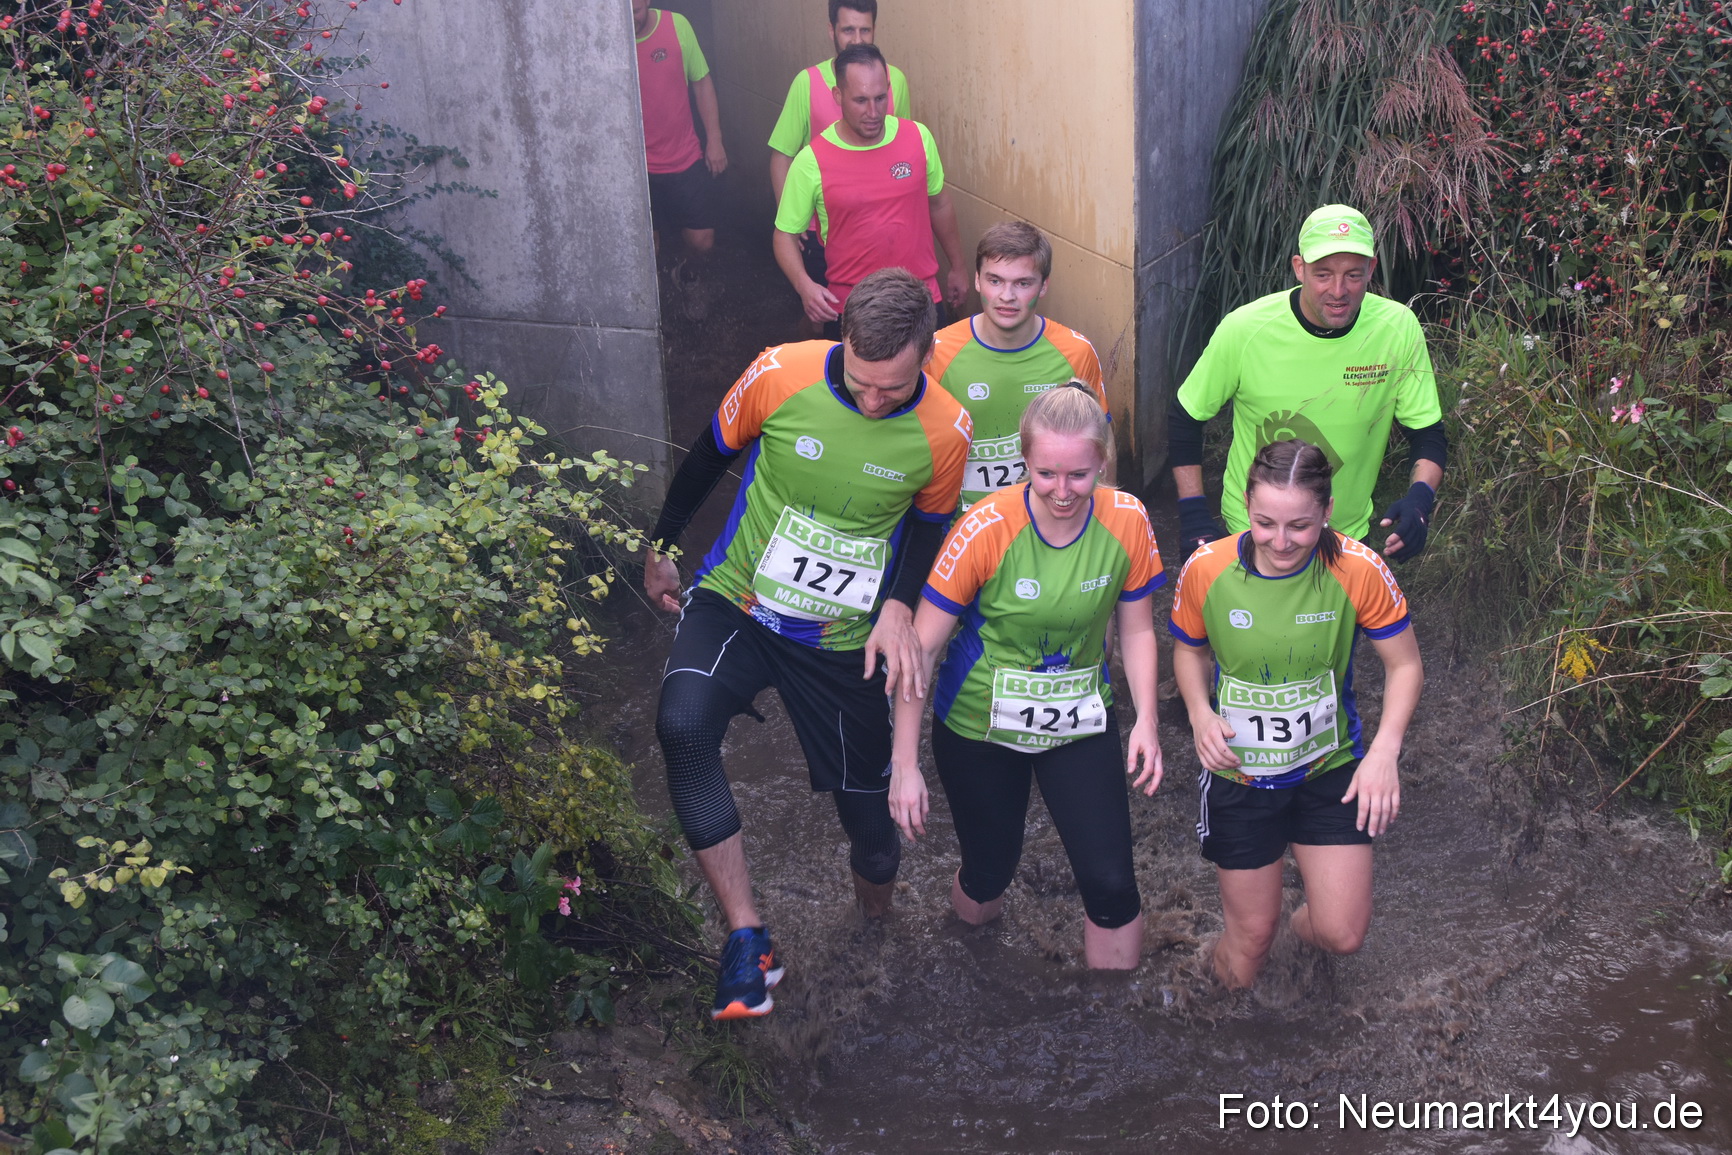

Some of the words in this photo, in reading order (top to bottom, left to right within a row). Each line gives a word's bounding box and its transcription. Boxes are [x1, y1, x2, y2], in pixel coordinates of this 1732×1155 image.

[863, 462, 906, 482] BOCK
[784, 515, 879, 566] BOCK
[934, 502, 1004, 581] BOCK
[792, 556, 857, 597] 127
[774, 586, 844, 618] MARTIN
[1296, 610, 1336, 624] BOCK
[1003, 672, 1093, 699] BOCK
[1228, 677, 1325, 709] BOCK
[1019, 706, 1080, 732] 121
[1248, 711, 1312, 743] 131
[1244, 740, 1318, 765] DANIELA
